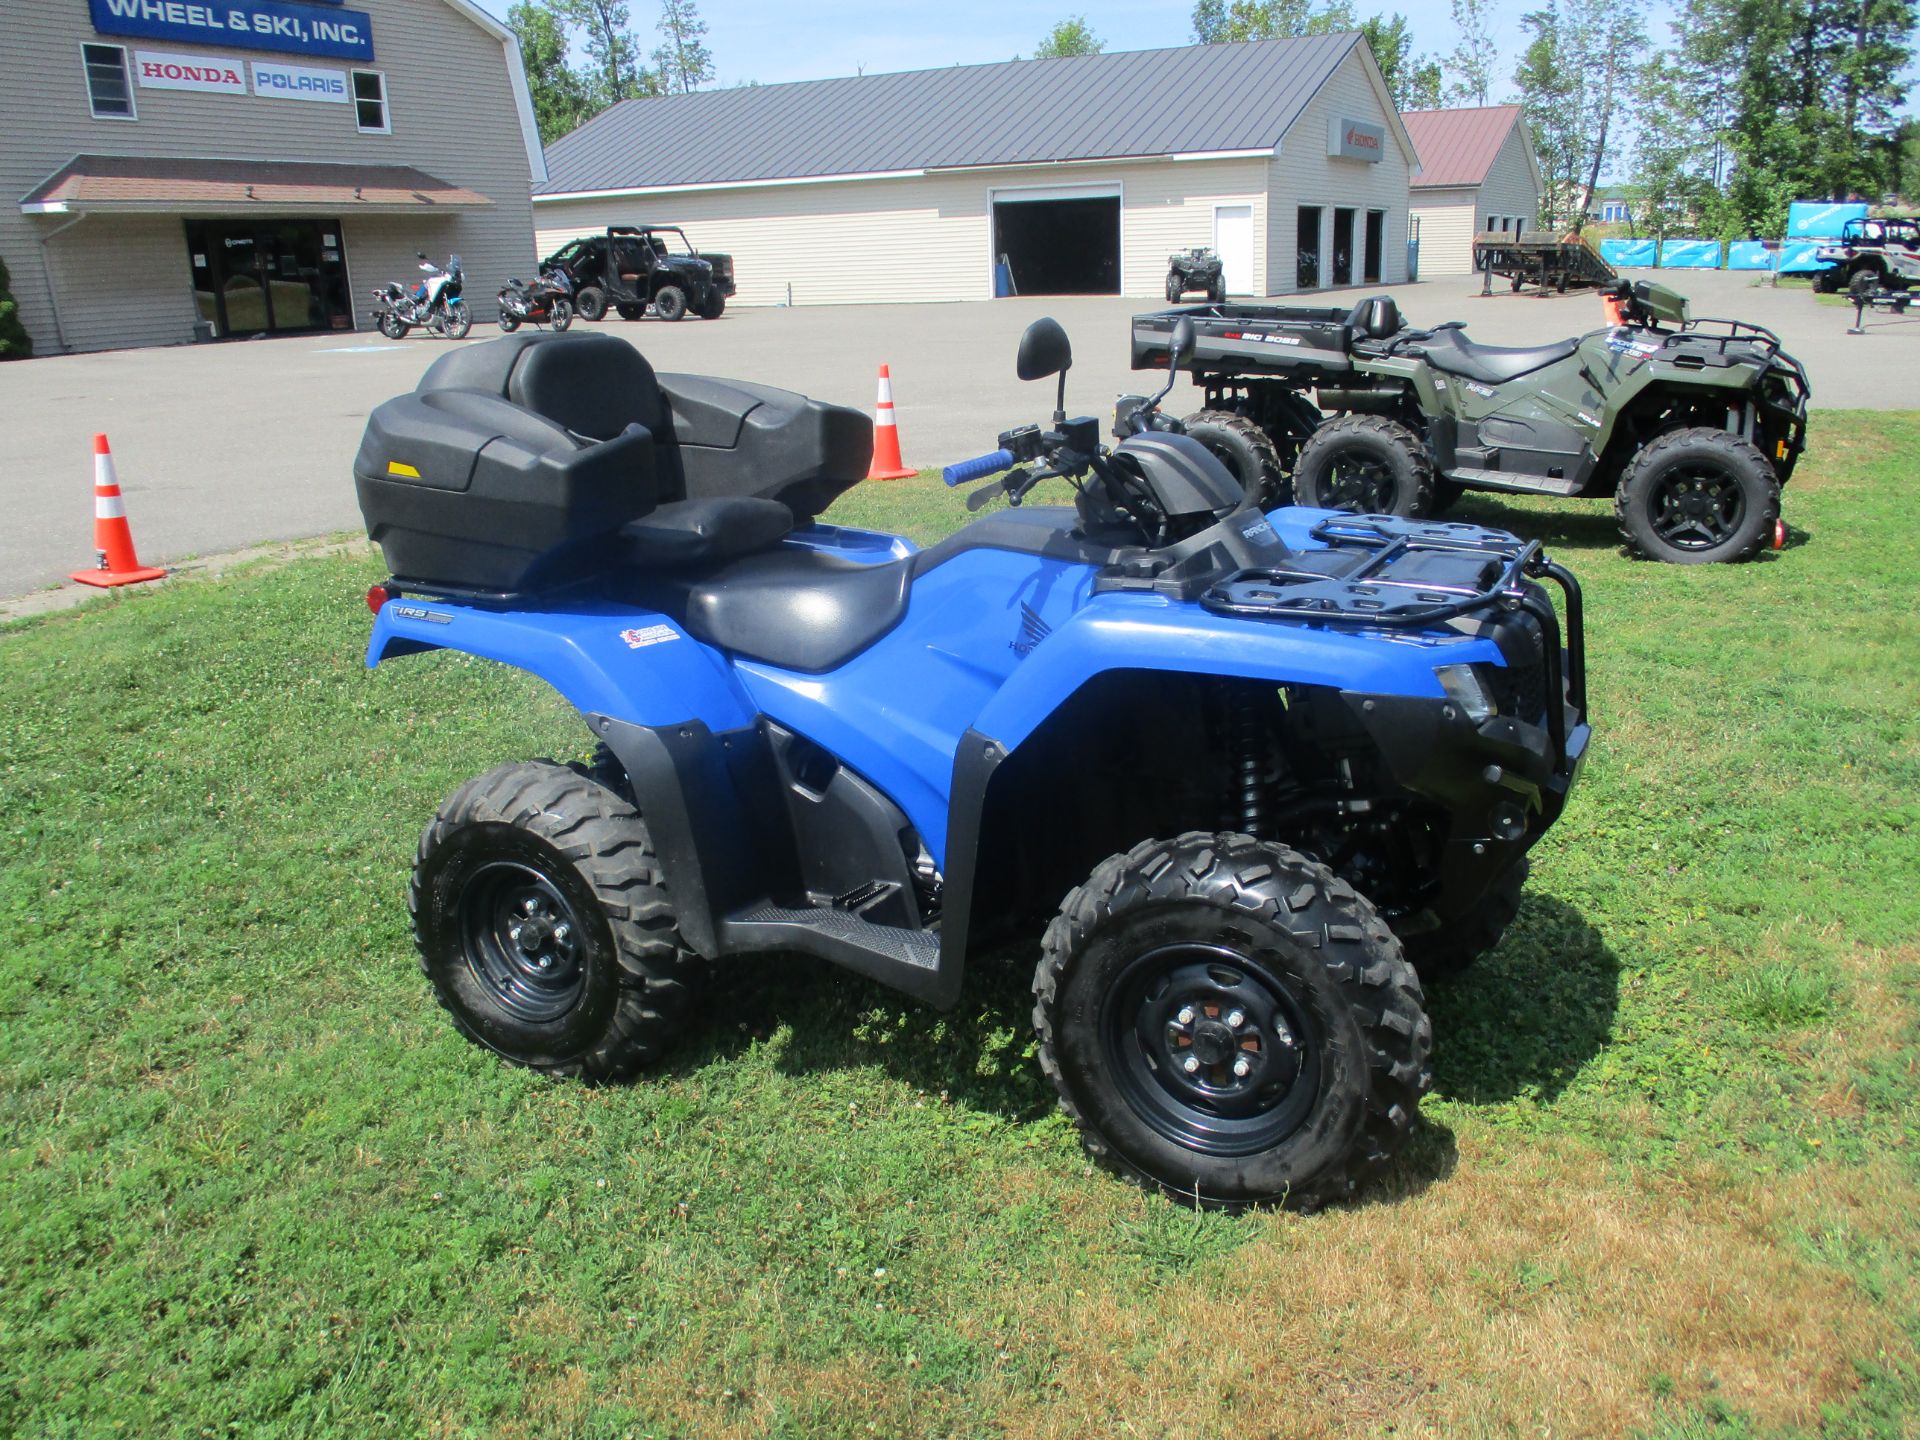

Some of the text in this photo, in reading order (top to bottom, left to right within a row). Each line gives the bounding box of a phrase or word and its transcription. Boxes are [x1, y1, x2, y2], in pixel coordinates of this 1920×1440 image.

[106, 0, 366, 45] WHEEL & SKI, INC.
[142, 62, 242, 84] HONDA
[256, 72, 344, 94] POLARIS
[1354, 133, 1379, 149] HONDA
[1242, 332, 1263, 341] BIG
[1264, 335, 1300, 345] BOSS
[399, 607, 427, 617] IRS
